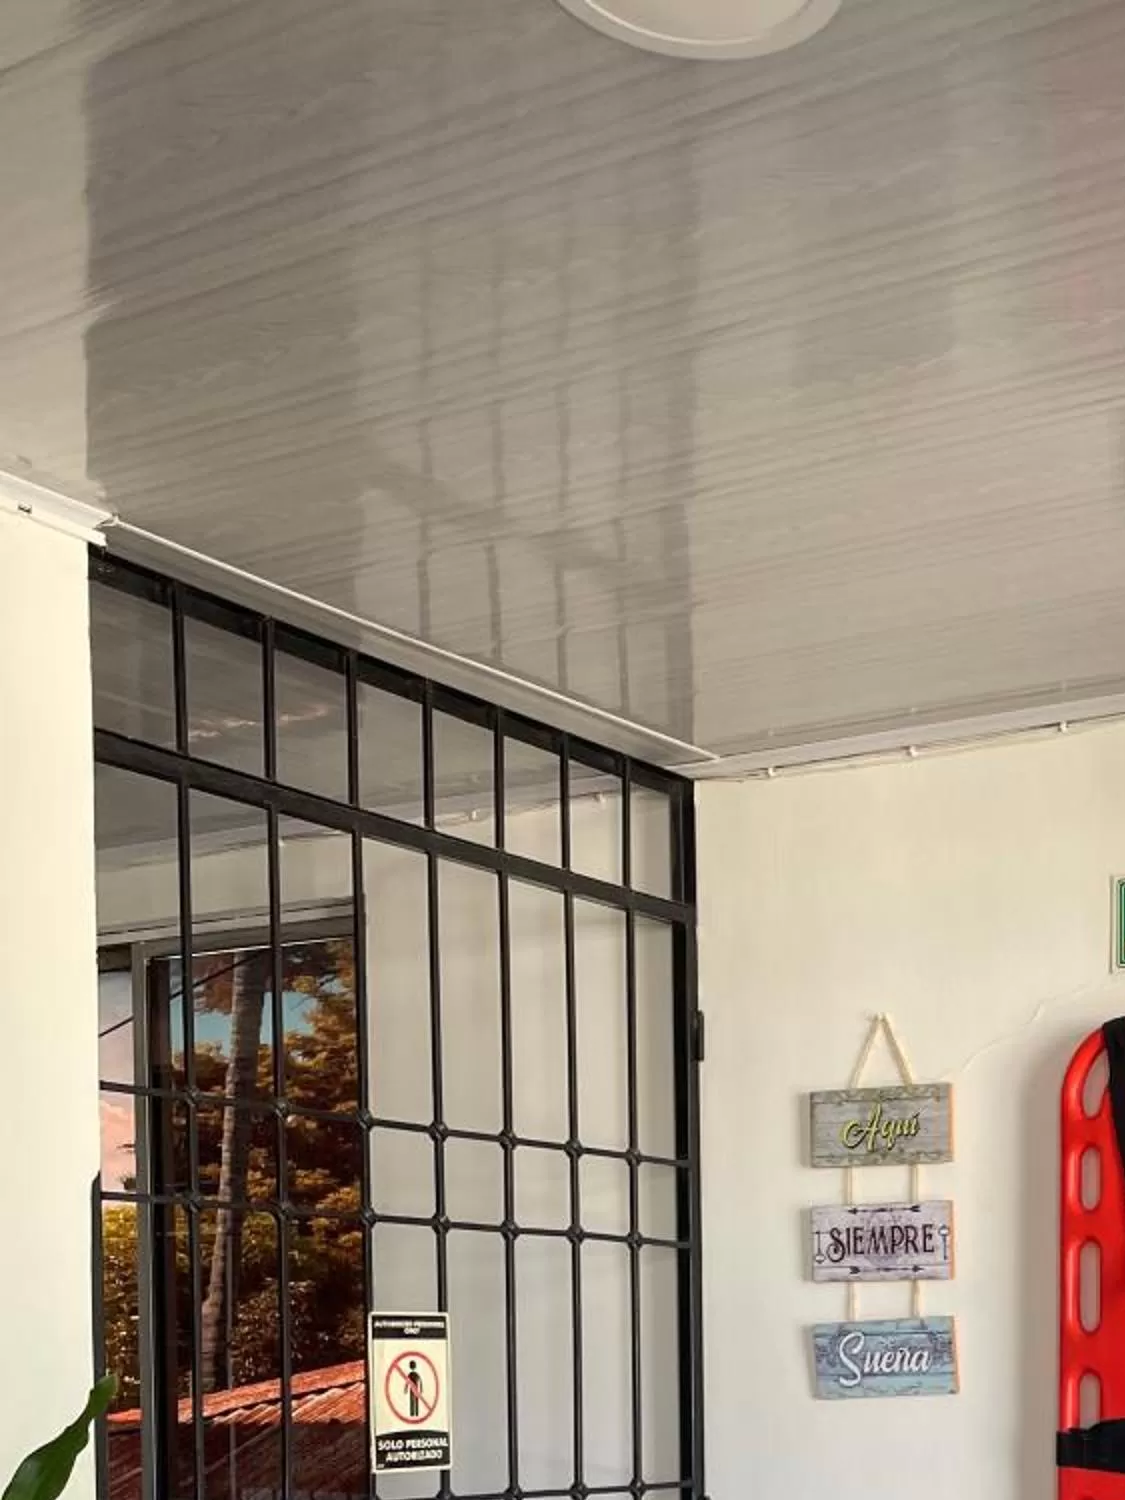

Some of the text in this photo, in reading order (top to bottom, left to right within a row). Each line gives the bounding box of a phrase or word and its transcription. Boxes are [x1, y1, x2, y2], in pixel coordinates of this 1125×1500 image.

[841, 1103, 920, 1150] Aquí
[827, 1224, 936, 1263] SIEMPRE
[378, 1440, 404, 1451] SOLO
